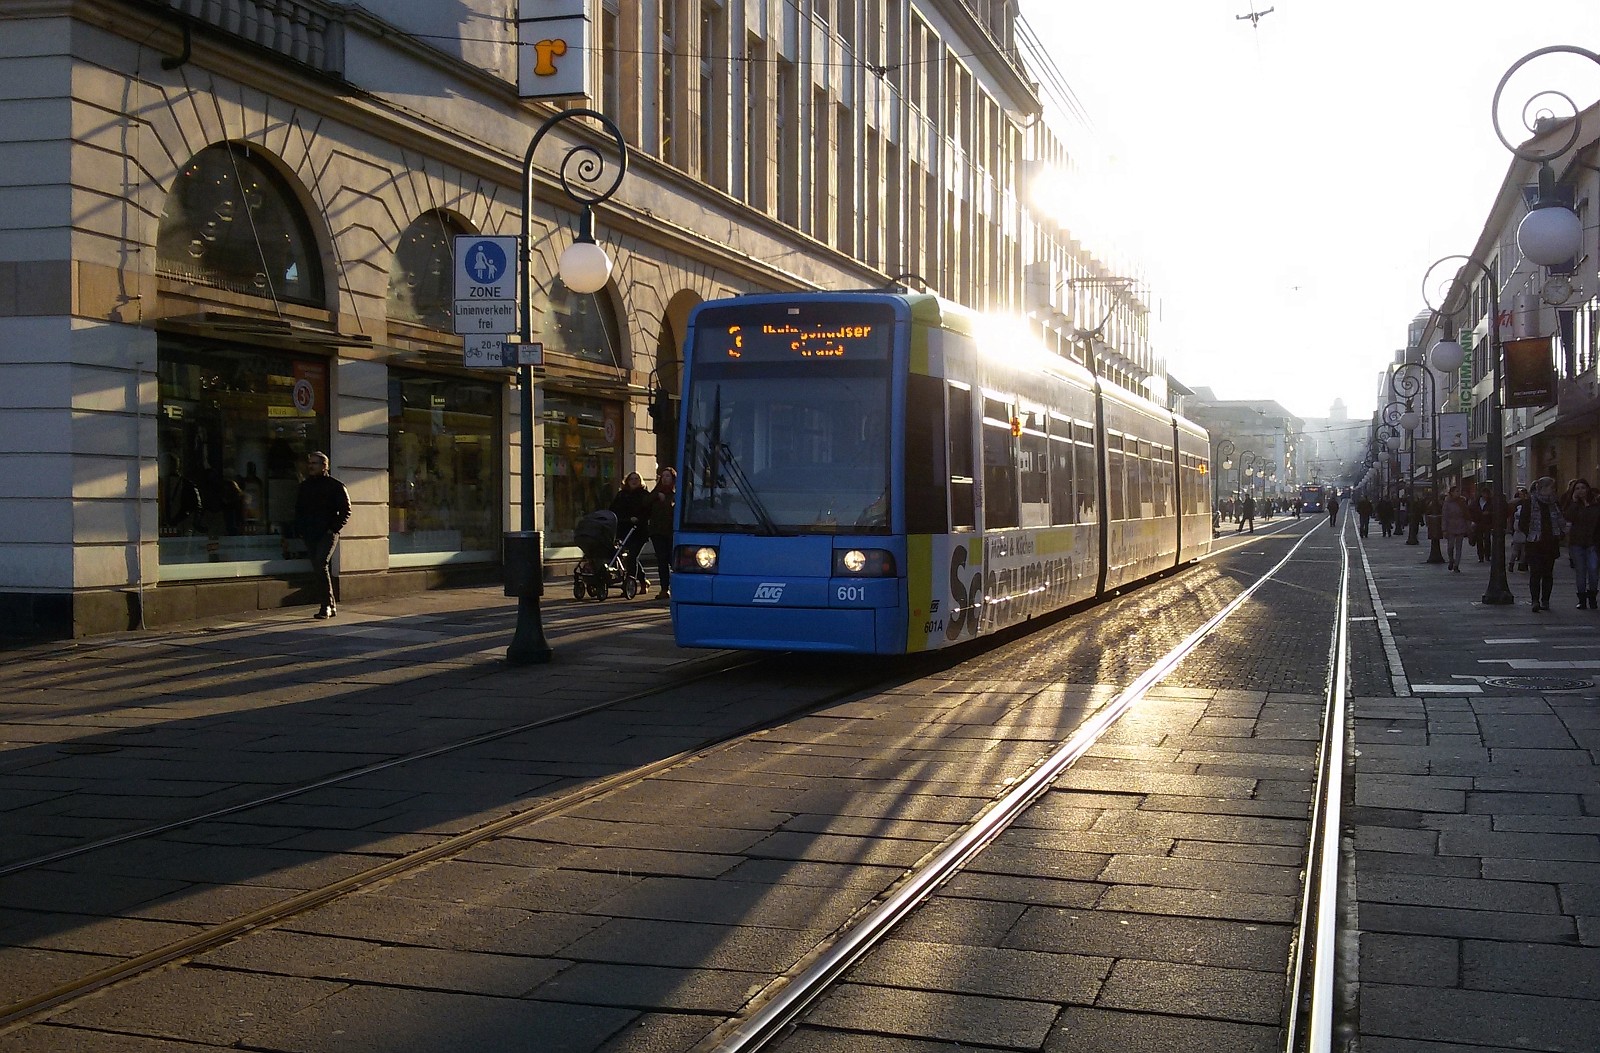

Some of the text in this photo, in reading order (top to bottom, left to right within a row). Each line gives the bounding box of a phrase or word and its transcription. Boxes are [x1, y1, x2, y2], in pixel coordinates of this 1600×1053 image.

[534, 38, 567, 76] r
[470, 286, 501, 297] ZONE
[455, 304, 513, 316] Linienverkehr
[478, 318, 493, 329] frei
[1460, 329, 1473, 431] EICHMANN
[753, 585, 785, 601] KVG
[837, 586, 865, 600] 601
[924, 619, 943, 634] 601A
